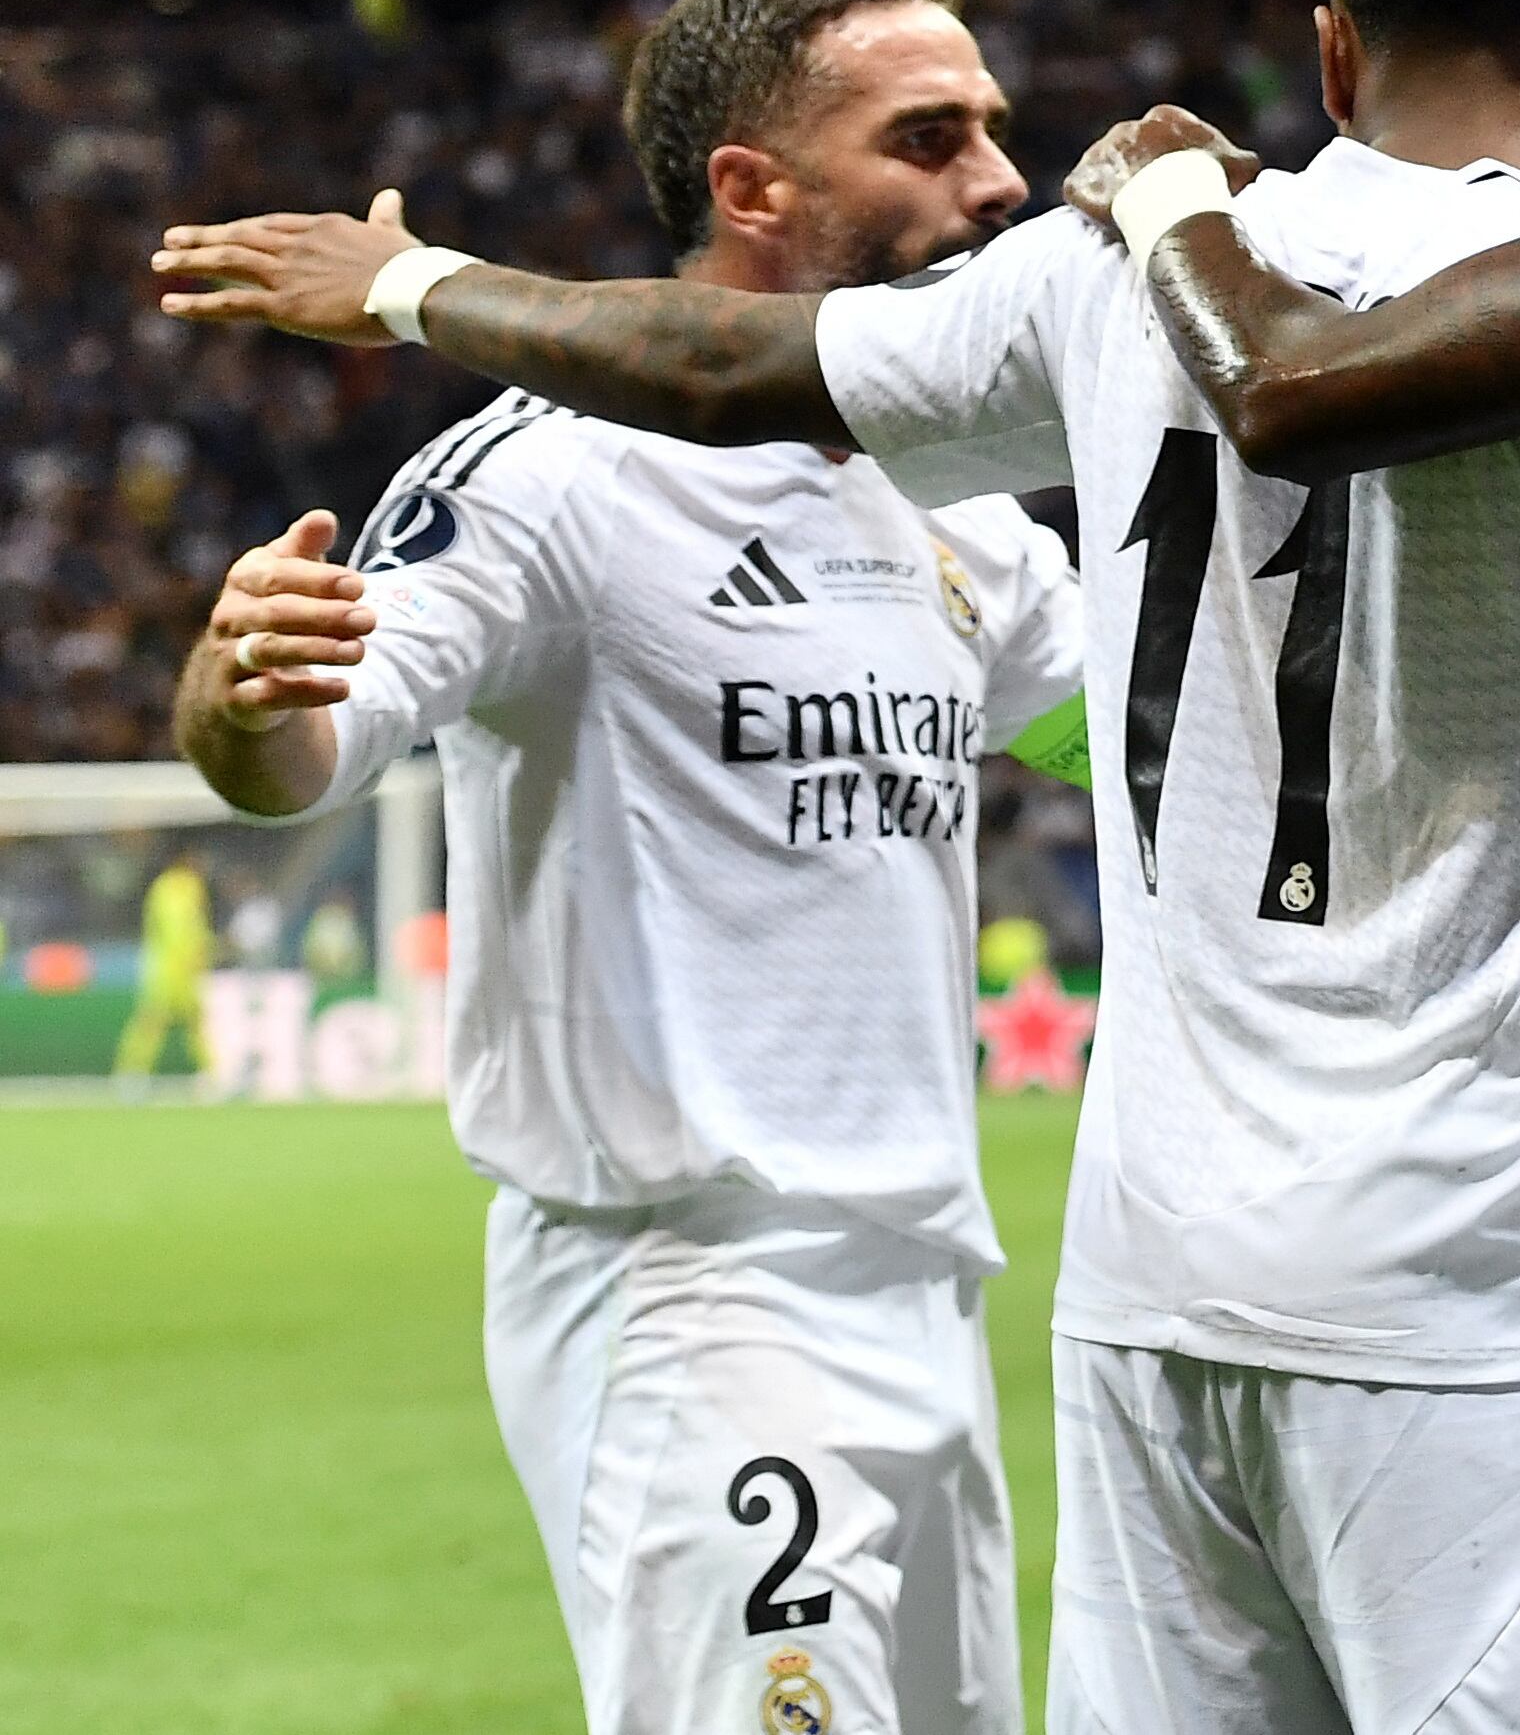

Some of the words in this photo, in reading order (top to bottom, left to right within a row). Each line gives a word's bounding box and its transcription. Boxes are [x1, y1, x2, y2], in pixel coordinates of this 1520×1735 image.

[1116, 427, 1352, 926] 11
[787, 772, 862, 845] FLY
[727, 1455, 833, 1637] 2
